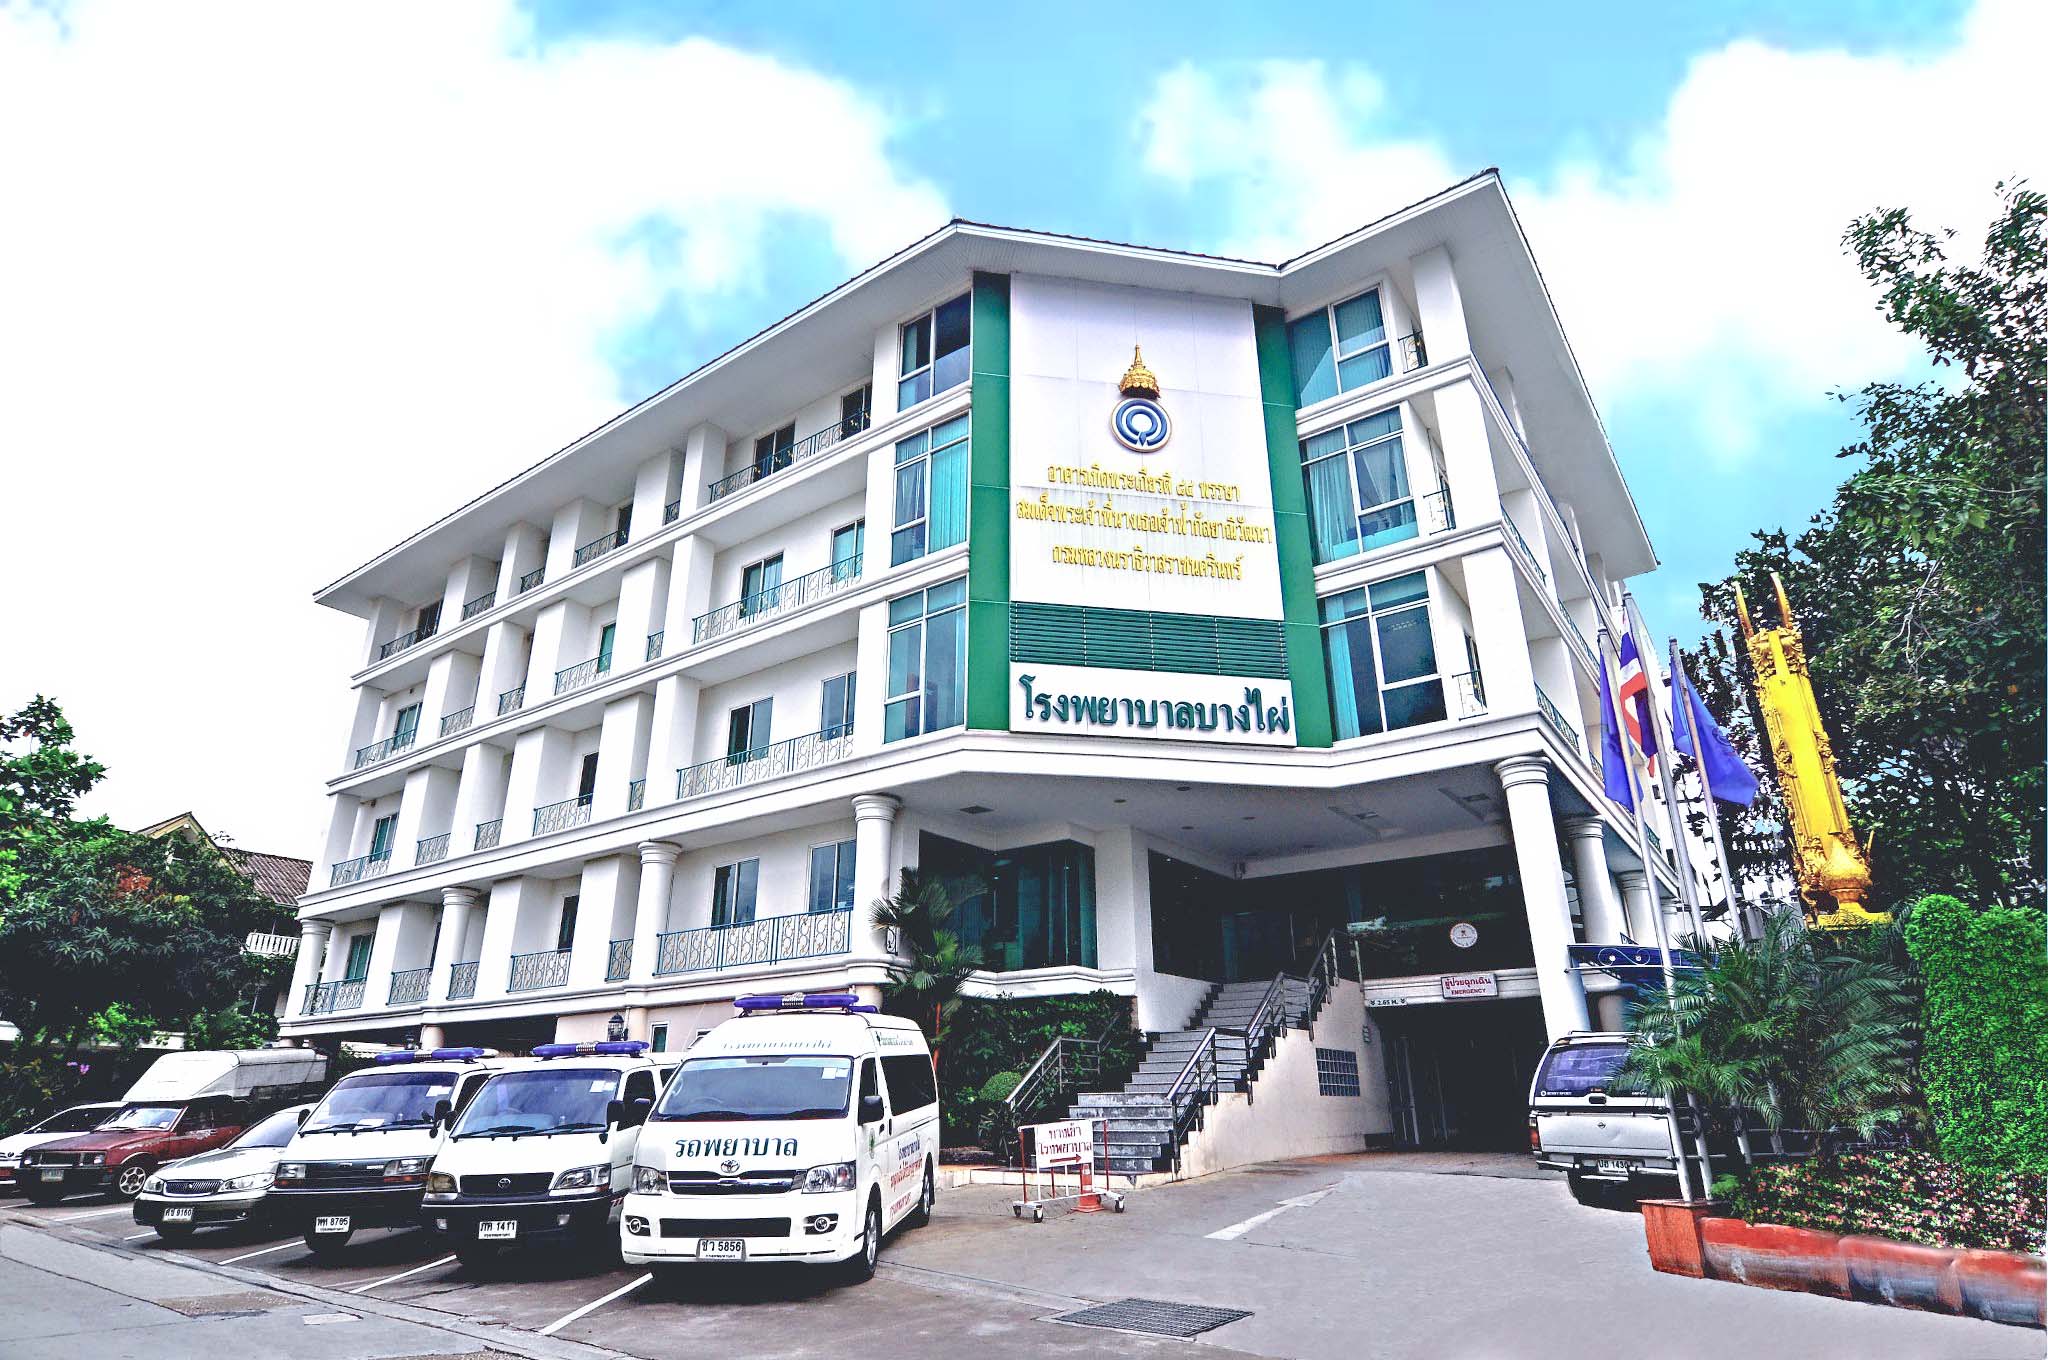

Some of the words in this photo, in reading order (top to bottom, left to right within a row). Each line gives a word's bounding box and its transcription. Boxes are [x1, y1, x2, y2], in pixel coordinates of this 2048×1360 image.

[1199, 480, 1241, 502] พรรษา
[1052, 545, 1244, 580] กรมหลวงนราธิวาสราชนครินทร์
[1018, 674, 1291, 733] โรงพยาบาลบางไผ่
[675, 1137, 799, 1158] รถพยาบาล
[1039, 1142, 1092, 1155] โรงพยาบาล
[718, 1241, 742, 1252] 5856
